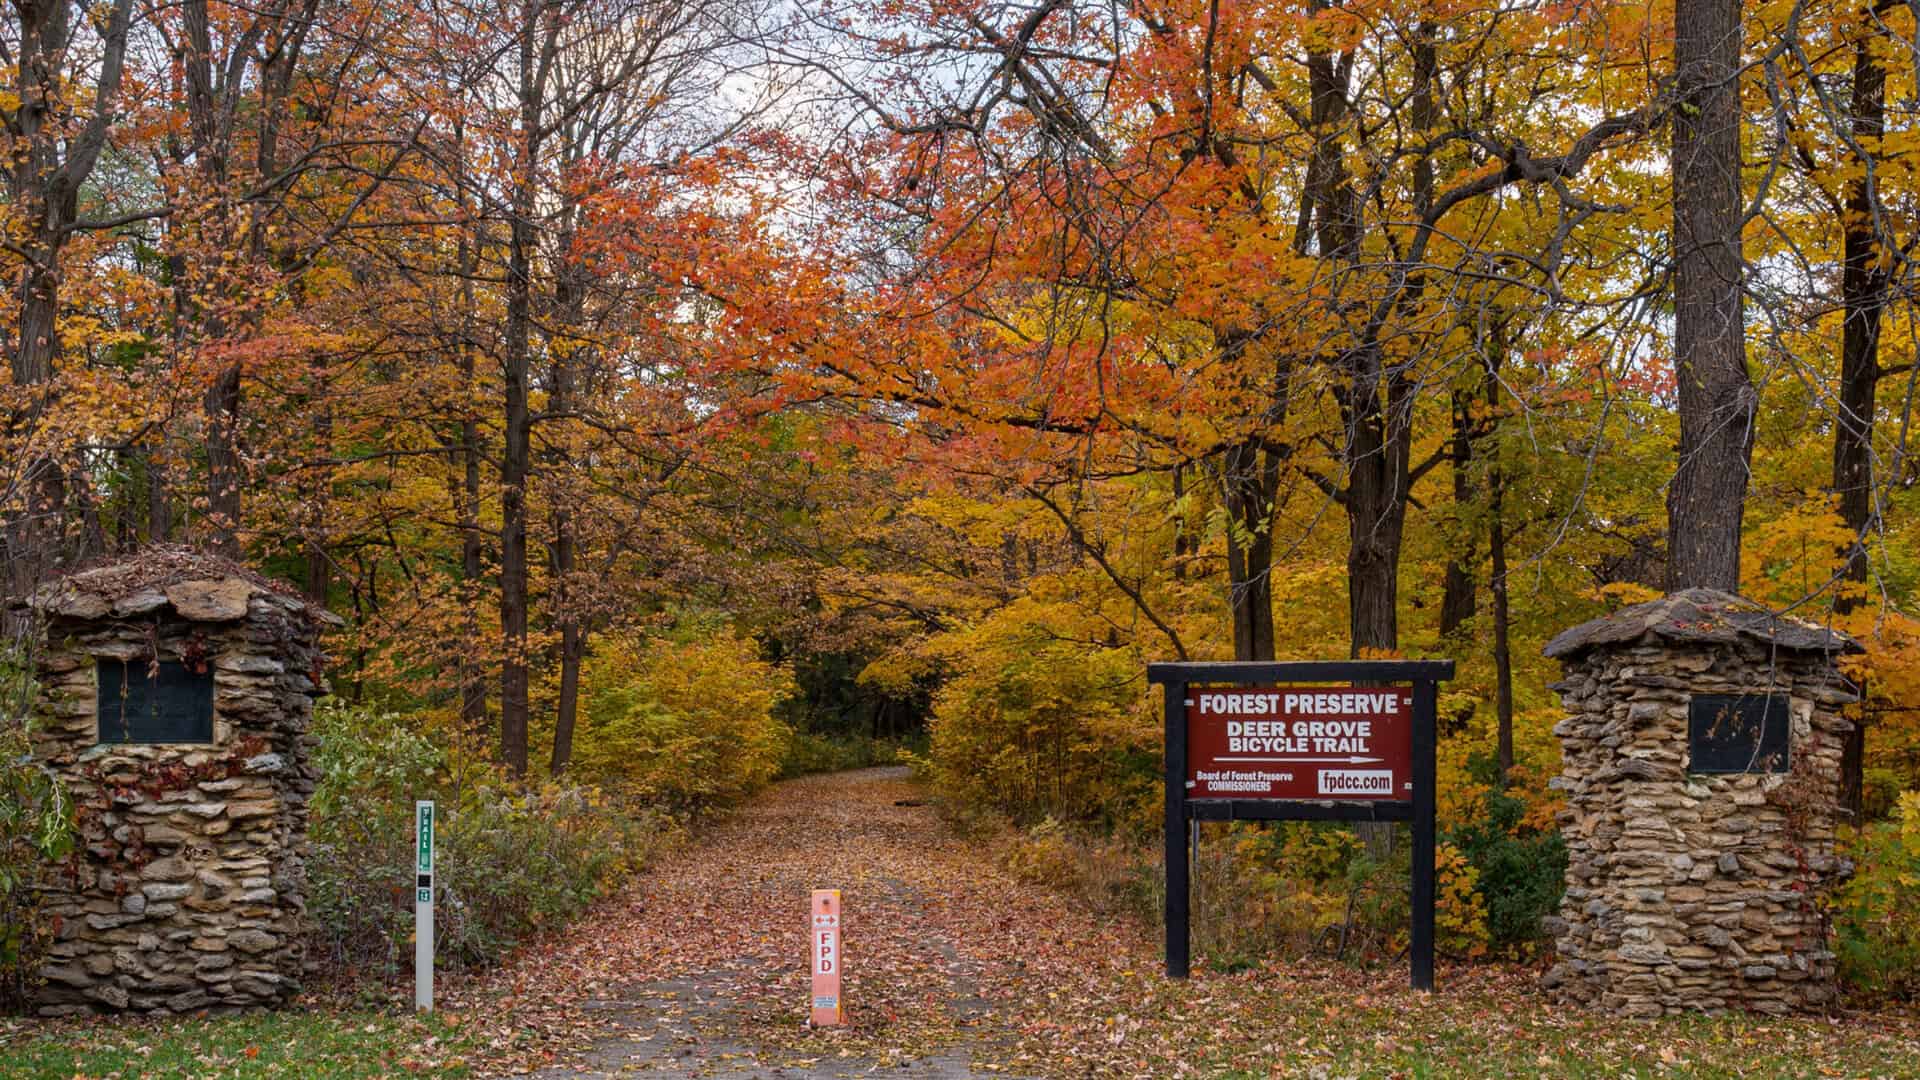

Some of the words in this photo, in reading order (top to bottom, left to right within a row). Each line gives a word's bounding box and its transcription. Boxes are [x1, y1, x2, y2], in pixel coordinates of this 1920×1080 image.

[1200, 694, 1280, 714] FOREST
[1284, 694, 1398, 714] PRESERVE
[1227, 721, 1286, 737] DEER
[1292, 721, 1371, 737] GROVE
[1229, 737, 1309, 753] BICYCLE
[1313, 737, 1370, 753] TRAIL
[1196, 770, 1219, 781] Board
[1221, 770, 1230, 781] of
[1231, 770, 1257, 781] Forest
[1258, 770, 1293, 782] Preserve
[1323, 772, 1391, 793] fpdcc.com
[1207, 781, 1272, 792] COMMISSIONERS
[422, 808, 430, 849] TRAIL
[821, 933, 832, 972] FPD
